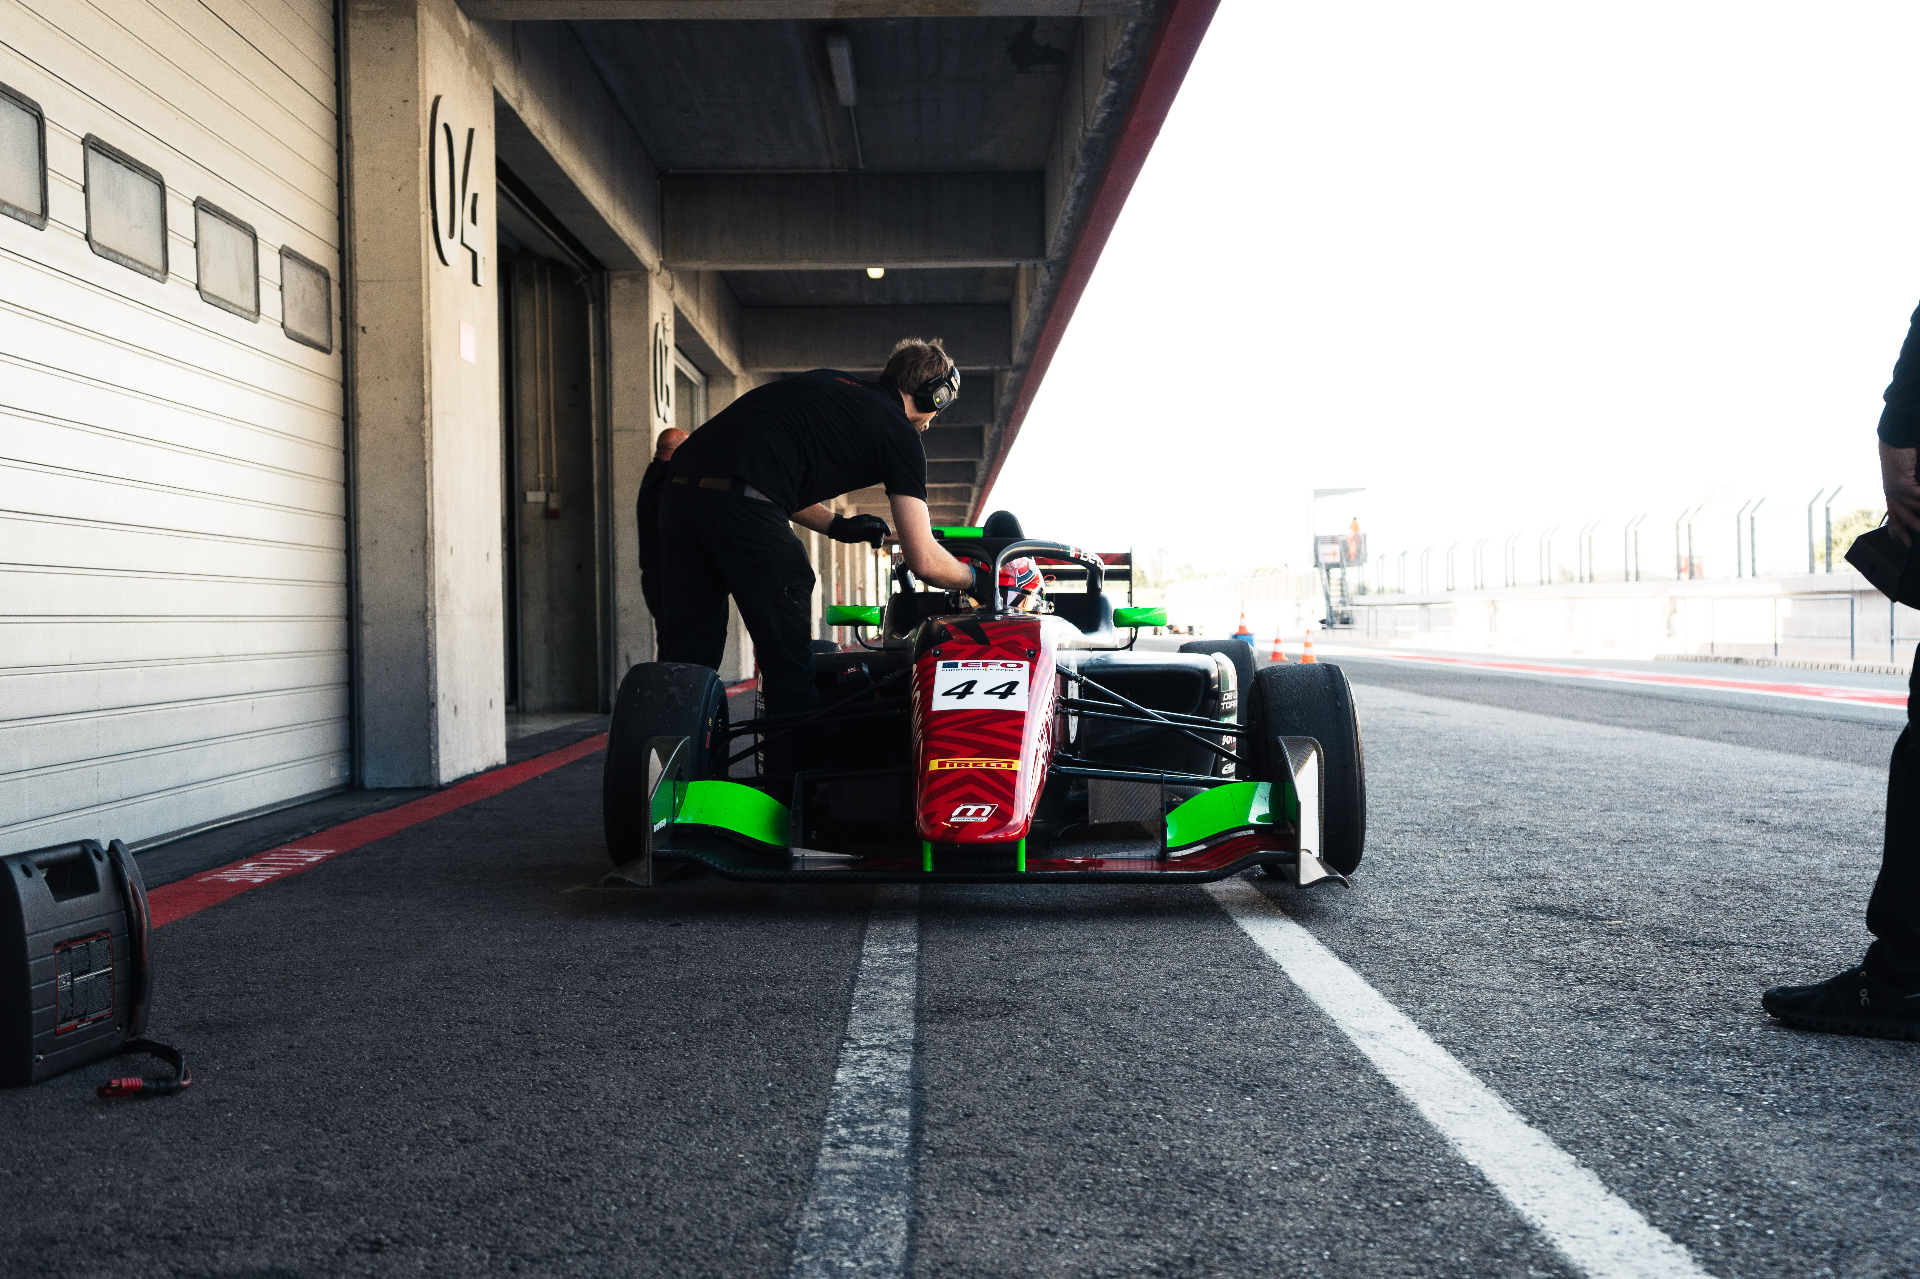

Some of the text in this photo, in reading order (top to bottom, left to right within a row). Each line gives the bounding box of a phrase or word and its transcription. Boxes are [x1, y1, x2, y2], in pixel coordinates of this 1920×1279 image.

[429, 94, 486, 287] 04
[961, 661, 1024, 669] EFO
[941, 679, 1020, 700] 44
[938, 760, 1015, 769] PIRELLI
